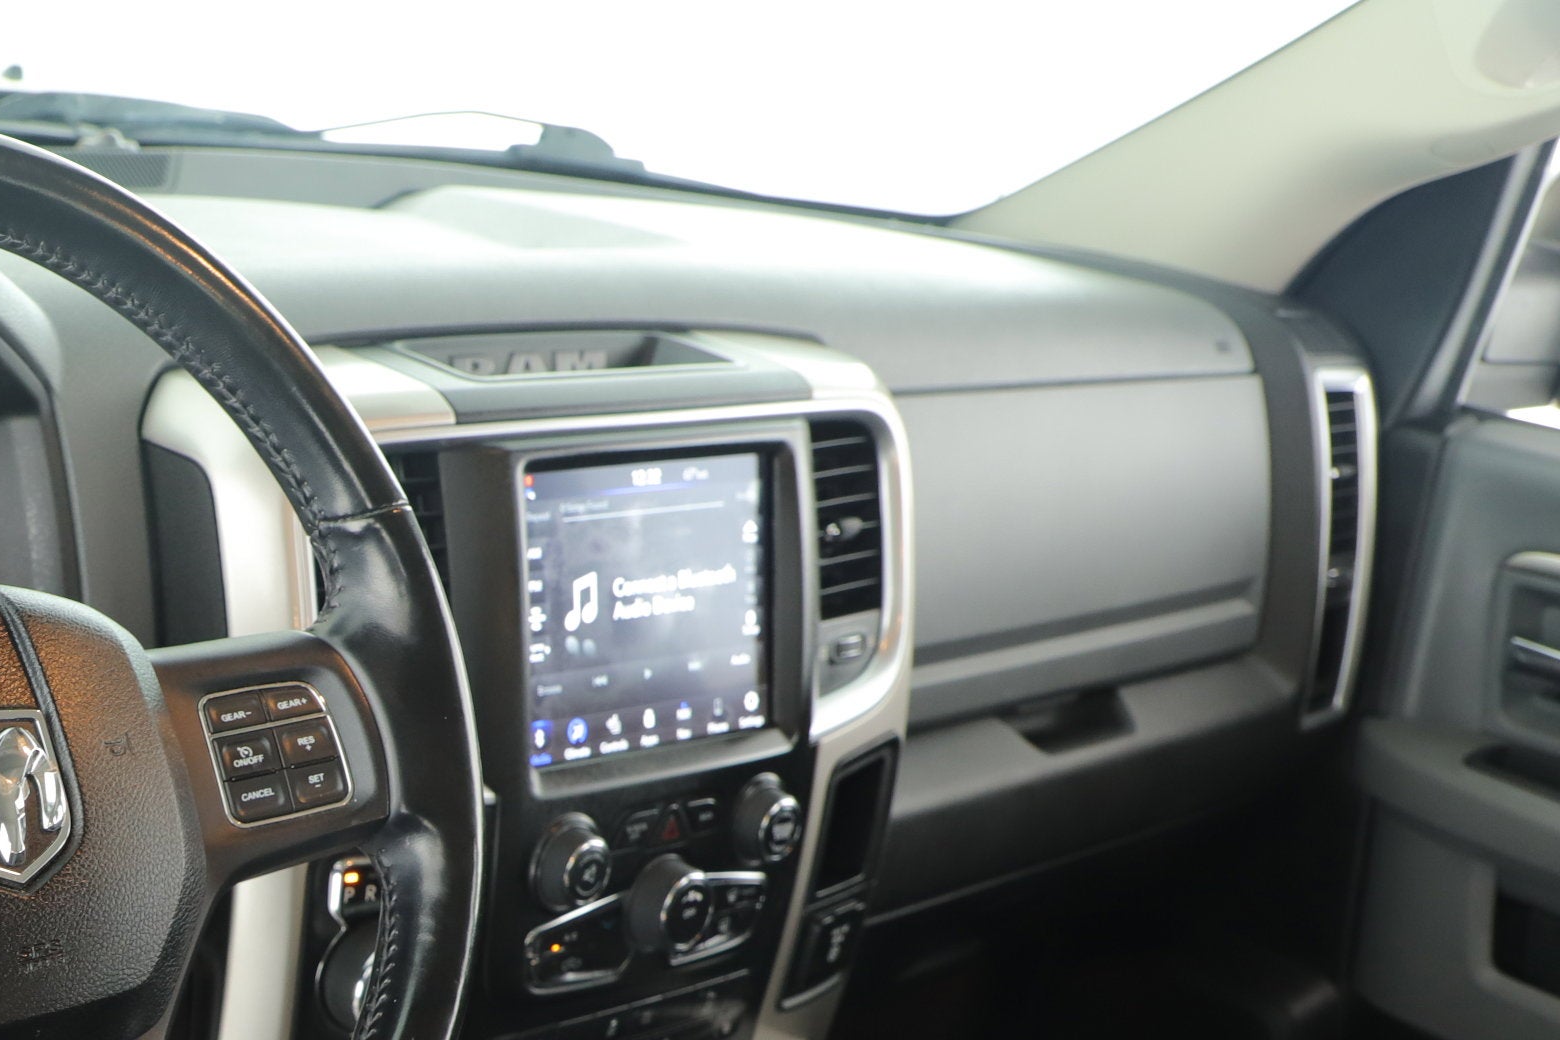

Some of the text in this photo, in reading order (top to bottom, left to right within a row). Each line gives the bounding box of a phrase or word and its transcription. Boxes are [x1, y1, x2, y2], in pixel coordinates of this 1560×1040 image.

[297, 735, 316, 746] RES
[233, 754, 265, 768] ON/OFF
[308, 772, 325, 785] SET
[241, 787, 275, 802] CANCEL
[343, 884, 377, 904] P R
